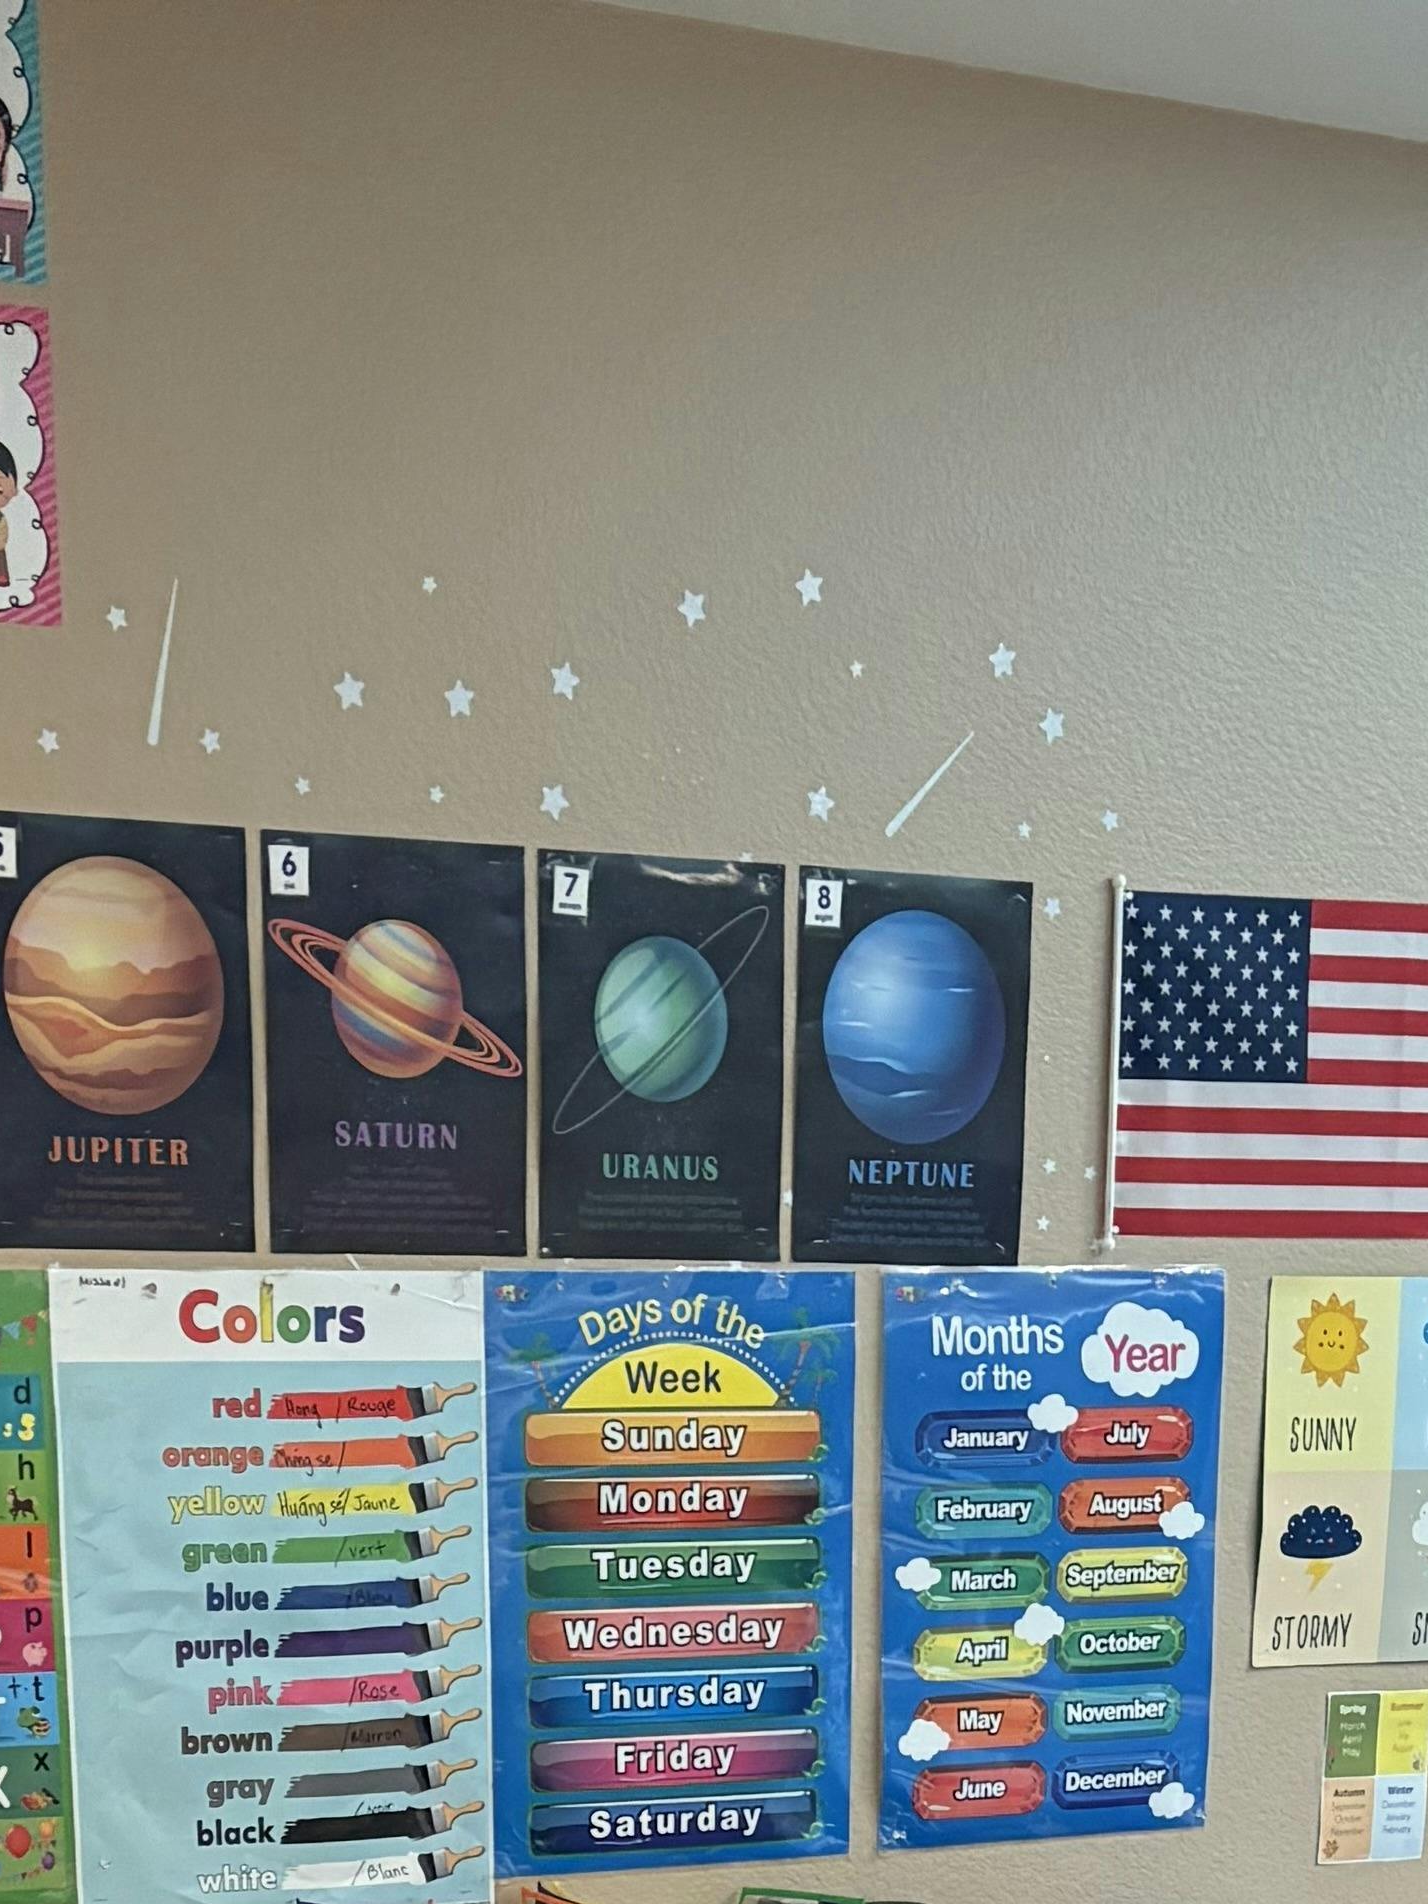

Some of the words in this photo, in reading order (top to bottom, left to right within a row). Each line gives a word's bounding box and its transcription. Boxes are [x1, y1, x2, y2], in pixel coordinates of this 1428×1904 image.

[334, 1121, 457, 1150] SATURN
[48, 1135, 189, 1166] JUPITER
[602, 1153, 718, 1180] URANUS
[849, 1159, 974, 1188] NEPTUNE
[179, 1284, 366, 1344] Colors
[578, 1296, 663, 1348] Days
[670, 1293, 706, 1324] of
[715, 1300, 765, 1350] the
[931, 1315, 1064, 1355] Months
[1105, 1334, 1185, 1372] Year
[625, 1359, 721, 1394] Week
[960, 1364, 987, 1390] of
[992, 1363, 1031, 1390] the
[212, 1388, 260, 1418] red
[601, 1420, 746, 1455] Sunday
[943, 1427, 1028, 1450] January
[1105, 1422, 1150, 1448] July
[1290, 1417, 1356, 1452] SUNNY
[163, 1445, 263, 1473] orange
[169, 1487, 266, 1523] yellow
[597, 1483, 748, 1519] Monday
[937, 1499, 1032, 1522] February
[1089, 1491, 1162, 1518] August
[182, 1540, 267, 1571] green
[591, 1549, 756, 1583] Tuesday
[950, 1569, 1016, 1592] March
[1066, 1562, 1177, 1588] September
[206, 1583, 268, 1611] blue
[563, 1615, 784, 1652] Wednesday
[1080, 1633, 1160, 1654] October
[1272, 1613, 1351, 1650] STORMY
[175, 1630, 269, 1666] purple
[956, 1637, 1007, 1665] April
[208, 1676, 271, 1713] pink
[583, 1678, 765, 1712] Thursday
[958, 1708, 1003, 1734] May
[1066, 1700, 1166, 1724] November
[181, 1727, 271, 1754] brown
[614, 1743, 736, 1777] Friday
[206, 1777, 274, 1807] gray
[954, 1779, 1006, 1800] June
[1065, 1768, 1165, 1791] December
[196, 1818, 275, 1847] black
[589, 1805, 761, 1840] Saturday
[198, 1865, 276, 1893] white
[367, 1865, 408, 1880] Blanc
